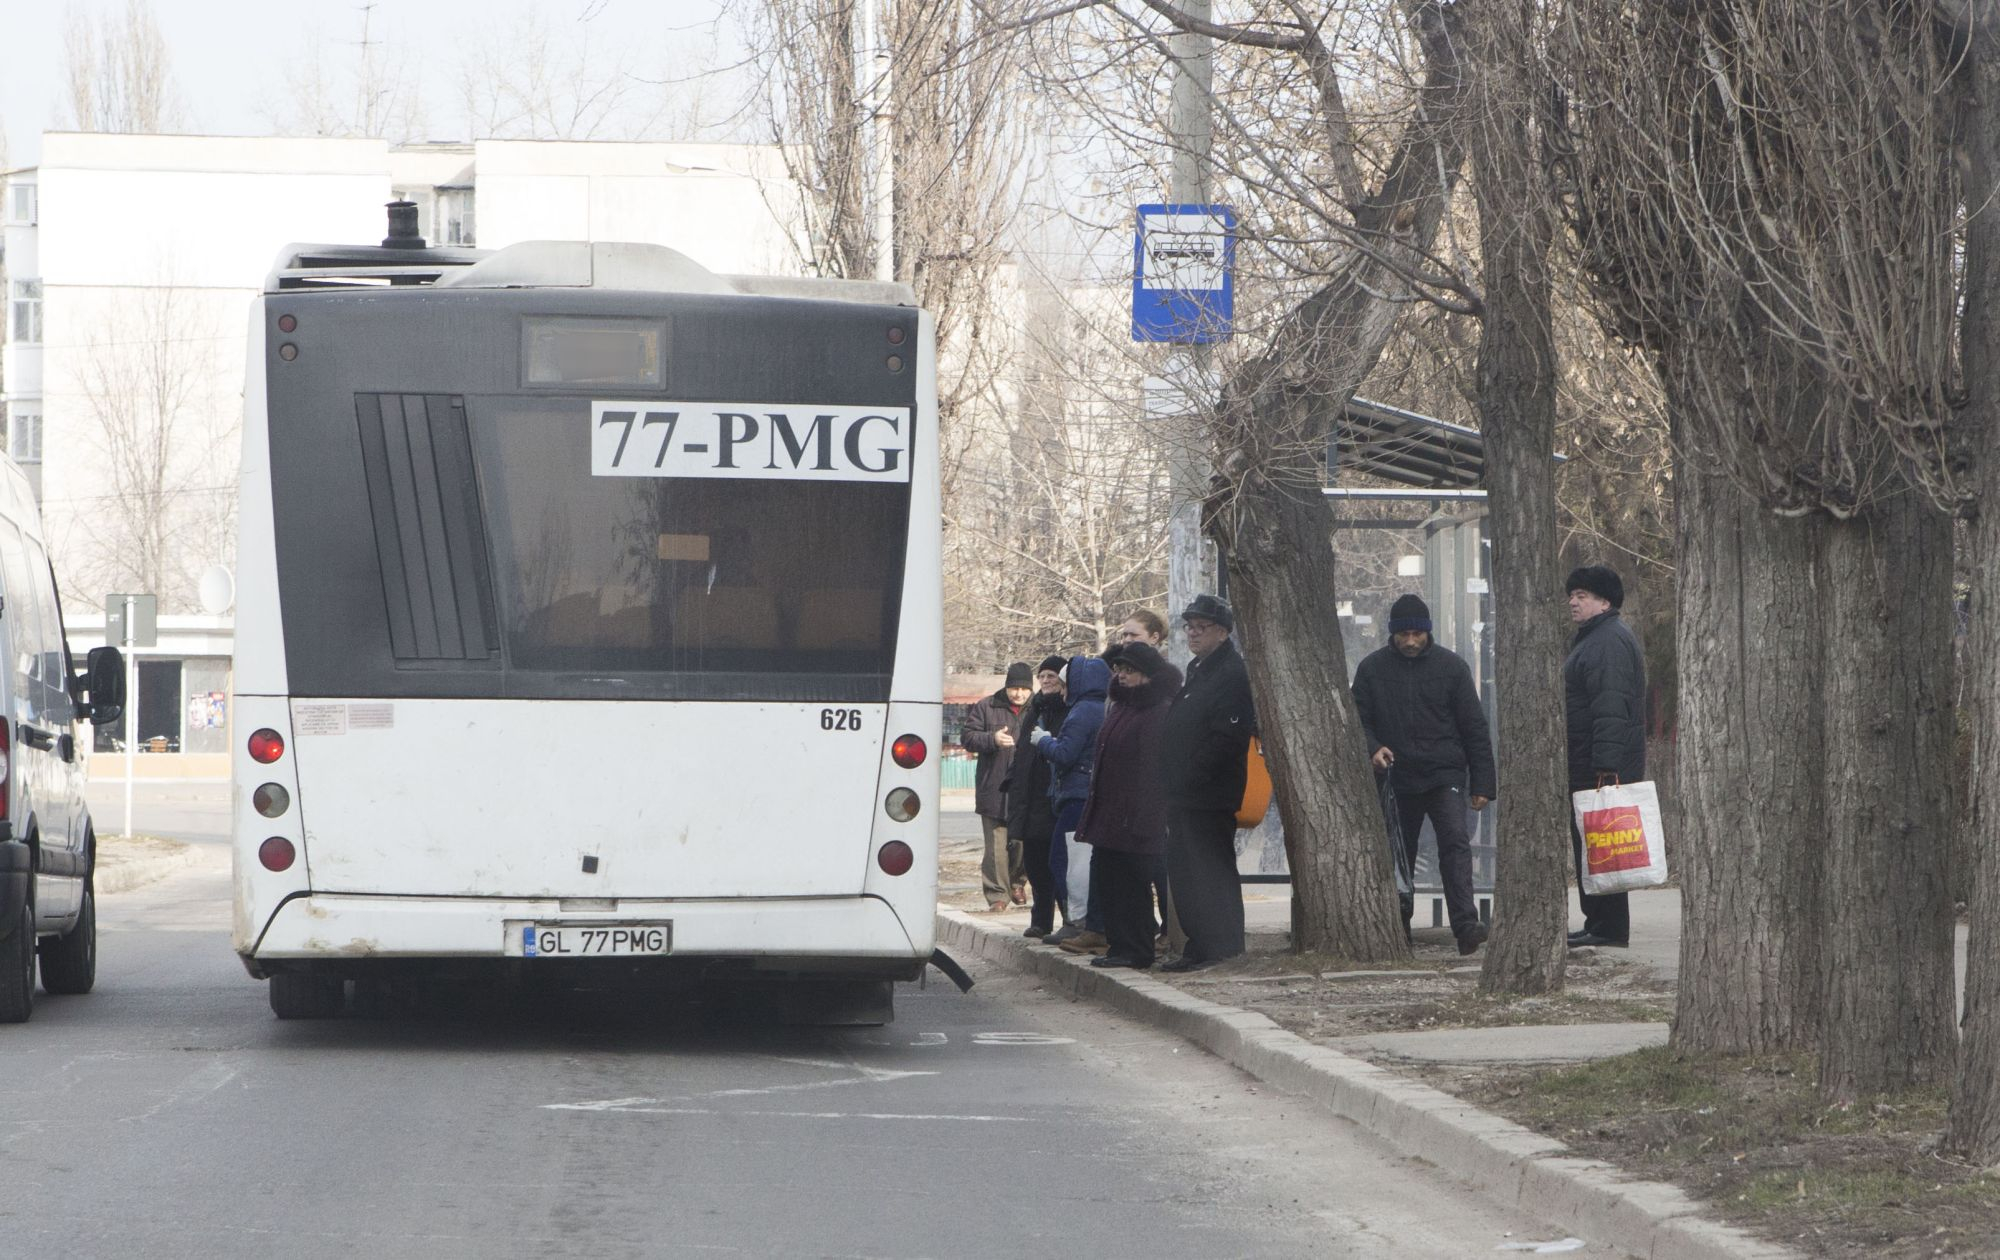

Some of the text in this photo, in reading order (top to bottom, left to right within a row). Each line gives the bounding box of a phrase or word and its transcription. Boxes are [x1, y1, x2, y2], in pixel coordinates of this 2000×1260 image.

[599, 410, 905, 473] 77-PMG
[821, 708, 862, 731] 626
[1586, 829, 1642, 848] PENNY
[540, 931, 570, 953] GL
